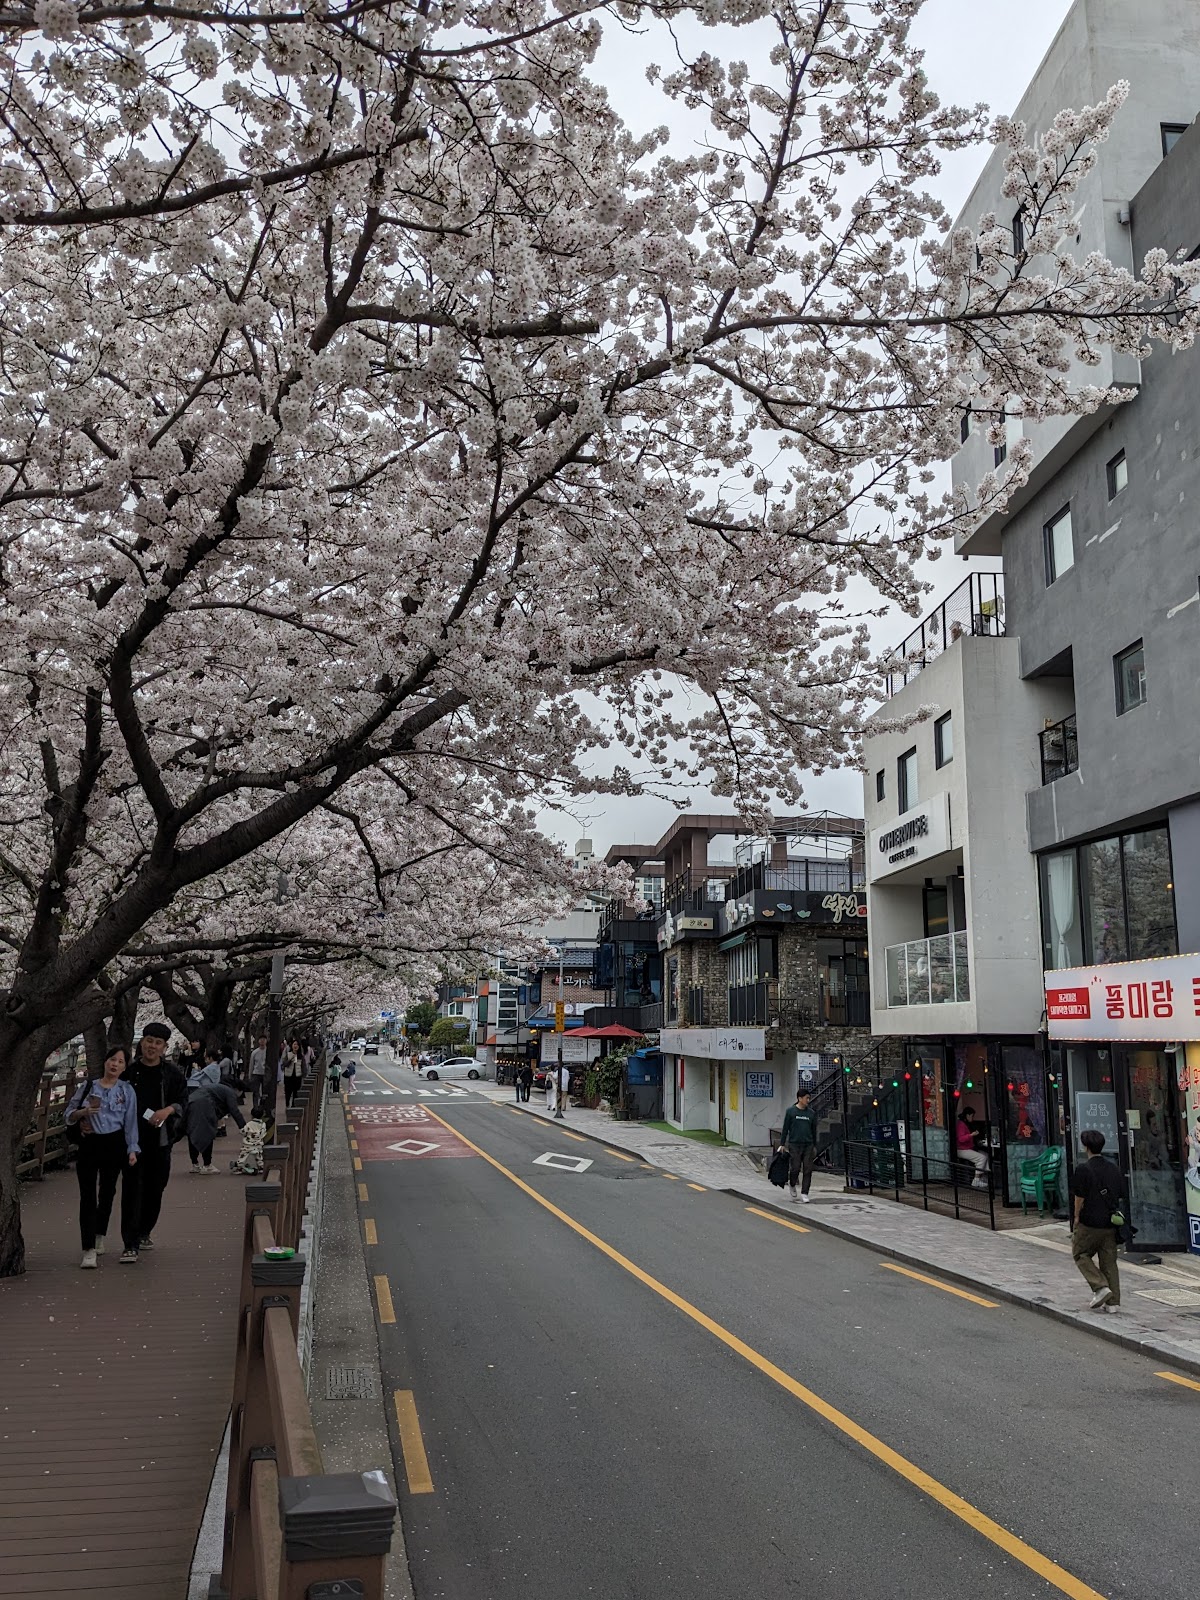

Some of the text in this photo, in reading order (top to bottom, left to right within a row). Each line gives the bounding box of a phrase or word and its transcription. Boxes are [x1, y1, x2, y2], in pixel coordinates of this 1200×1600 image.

[879, 814, 926, 853] OTHERWISE
[888, 850, 906, 864] COFFEE
[563, 975, 582, 989] 고기
[1105, 979, 1174, 1020] 풍미랑
[749, 1073, 770, 1085] 임대
